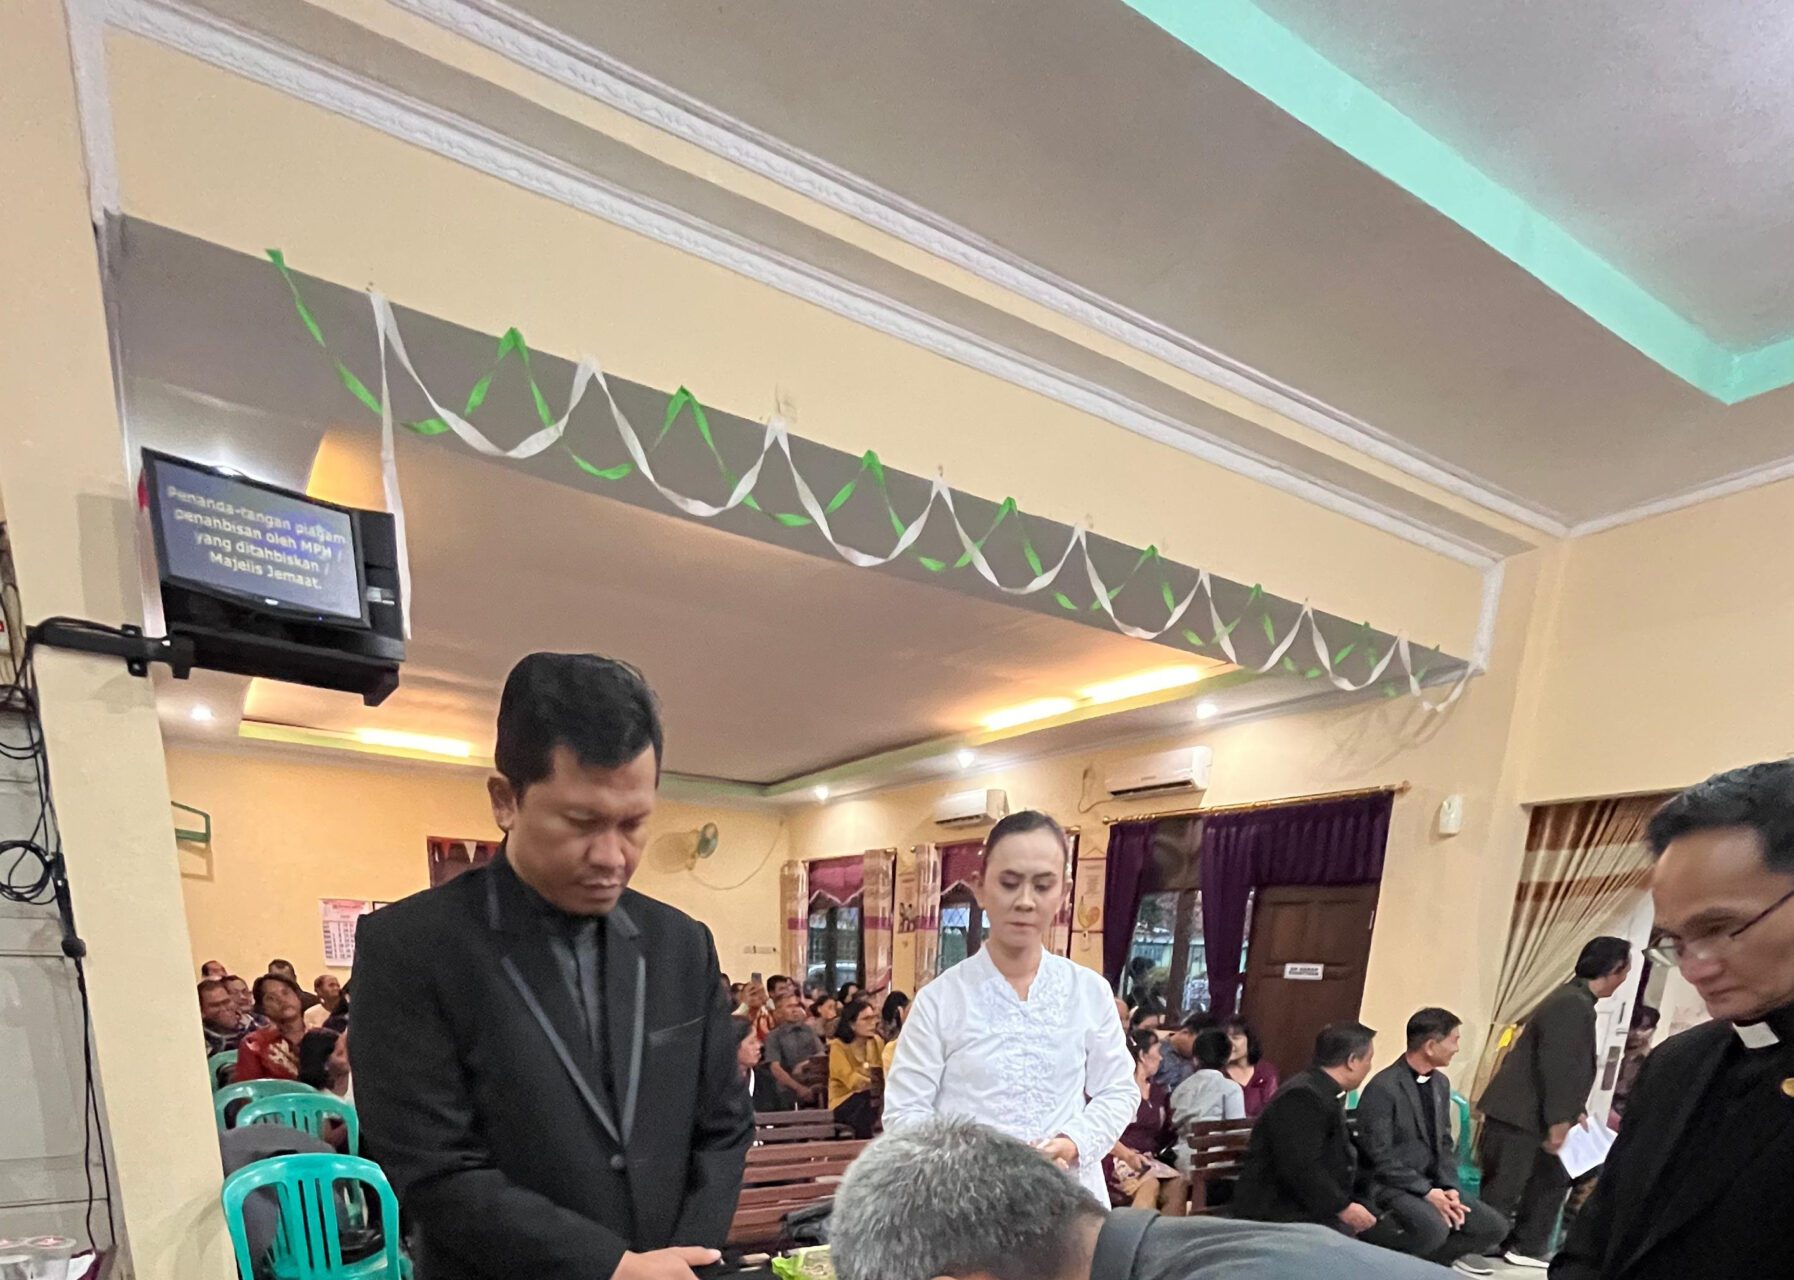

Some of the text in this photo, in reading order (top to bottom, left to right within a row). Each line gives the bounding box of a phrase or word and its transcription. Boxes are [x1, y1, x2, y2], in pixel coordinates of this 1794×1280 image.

[195, 531, 232, 552] yang
[236, 541, 319, 572] ditahbiskan
[266, 532, 297, 549] oleh
[209, 551, 322, 589] Majelis Jemaat.
